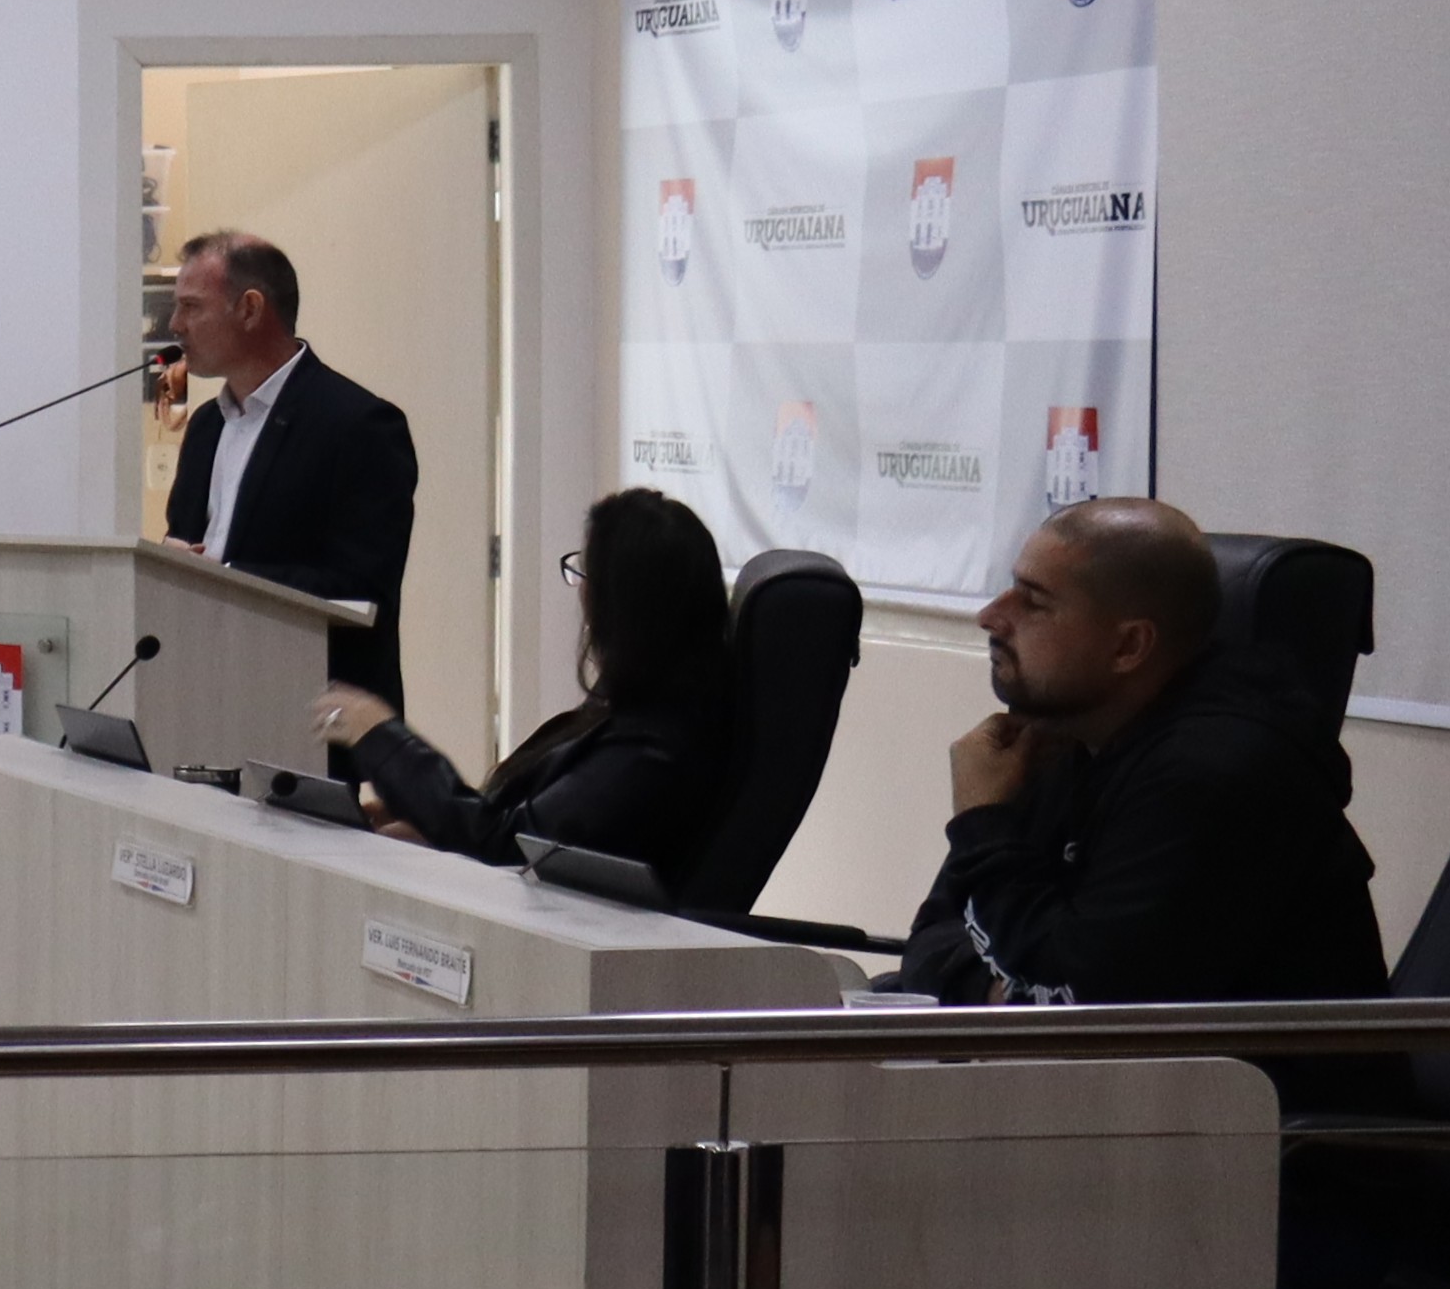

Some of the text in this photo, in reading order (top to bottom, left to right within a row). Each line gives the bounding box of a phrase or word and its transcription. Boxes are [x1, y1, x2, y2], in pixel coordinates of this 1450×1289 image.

[636, 0, 720, 38] URUGUAIANA
[744, 214, 845, 251] URUGUAIANA
[1021, 192, 1146, 236] URUGUAIANA
[877, 452, 981, 488] URUGUAIANA
